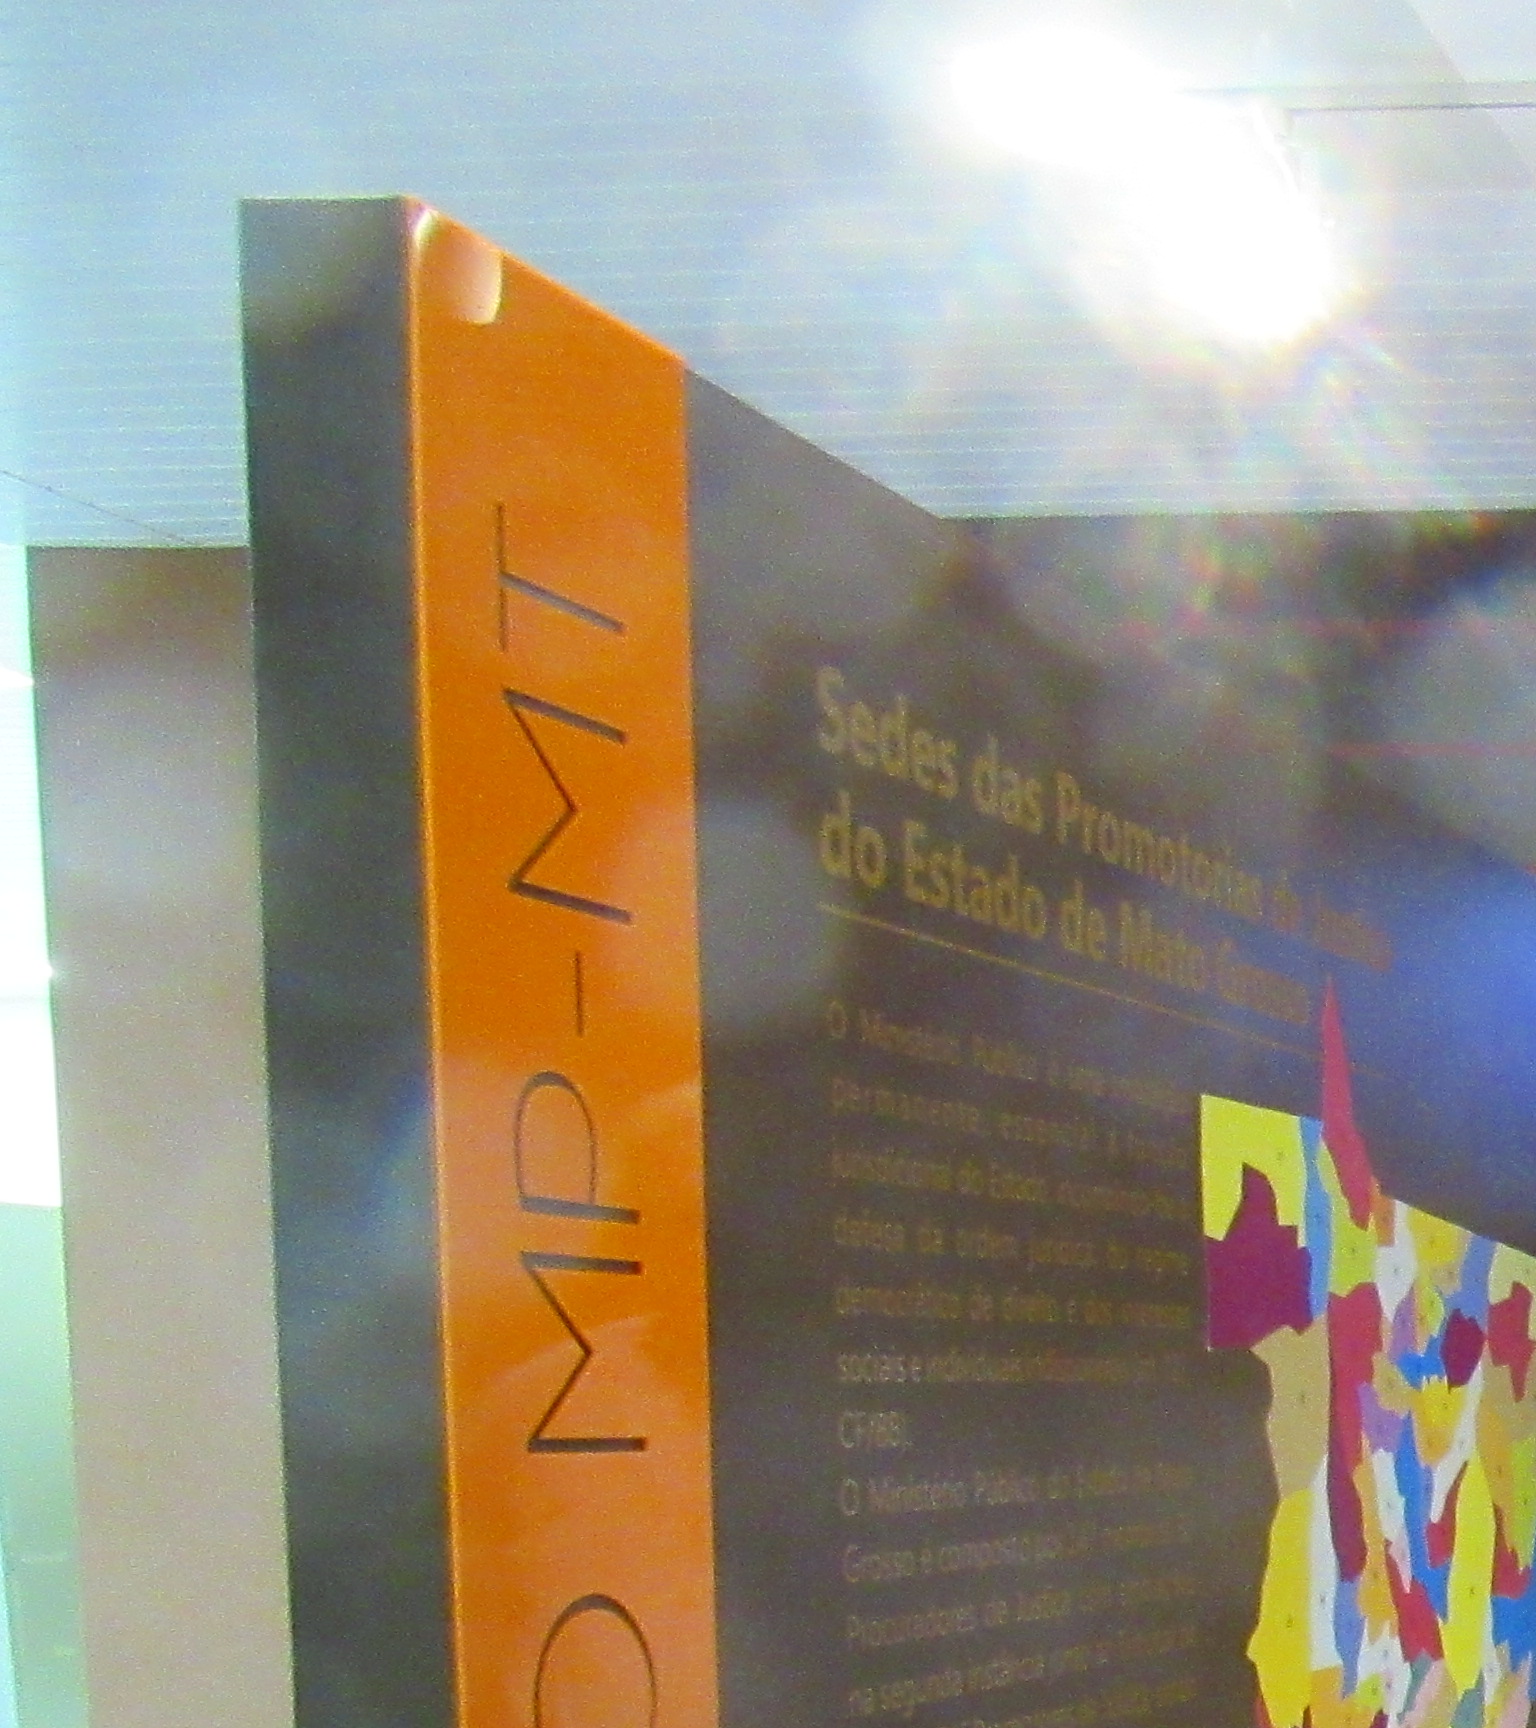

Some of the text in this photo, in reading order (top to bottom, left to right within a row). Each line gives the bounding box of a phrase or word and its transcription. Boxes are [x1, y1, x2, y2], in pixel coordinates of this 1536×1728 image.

[814, 665, 959, 799] Sedes
[970, 732, 1044, 834] das
[819, 788, 887, 889] do
[903, 818, 1046, 941] Estado
[1060, 878, 1106, 958] de
[491, 500, 648, 1453] MP-MT
